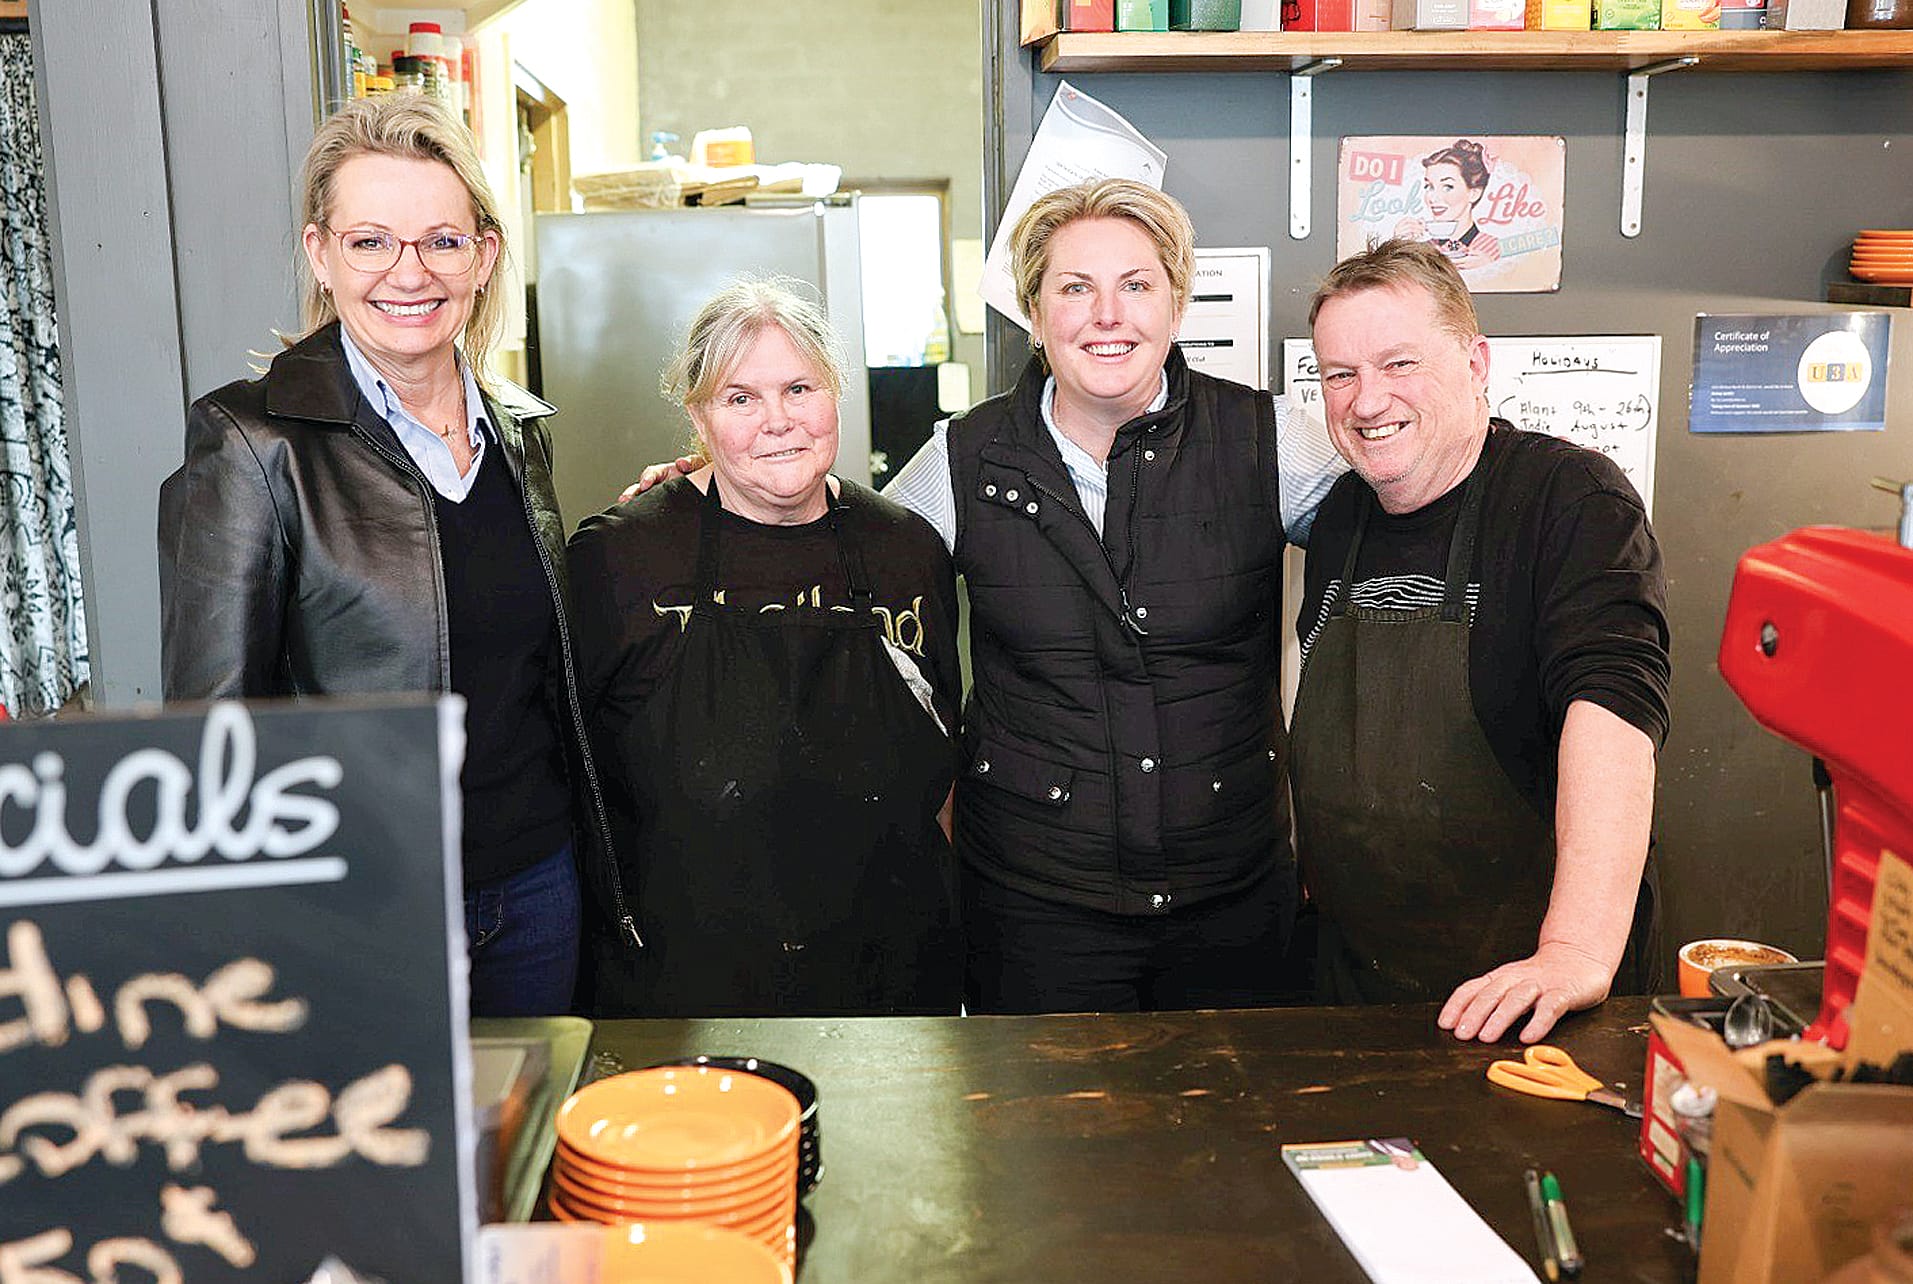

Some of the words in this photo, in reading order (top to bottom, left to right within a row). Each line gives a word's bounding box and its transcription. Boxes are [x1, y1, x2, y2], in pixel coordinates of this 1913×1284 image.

[1355, 156, 1384, 178] DO
[1389, 161, 1397, 180] I
[1350, 180, 1424, 223] Look
[1478, 183, 1546, 225] Like
[1714, 331, 1759, 341] Certificate
[1760, 330, 1770, 341] of
[1714, 343, 1769, 354] Appreciation
[1809, 364, 1861, 381] U3A
[1570, 419, 1629, 440] August
[0, 1062, 431, 1183] offee
